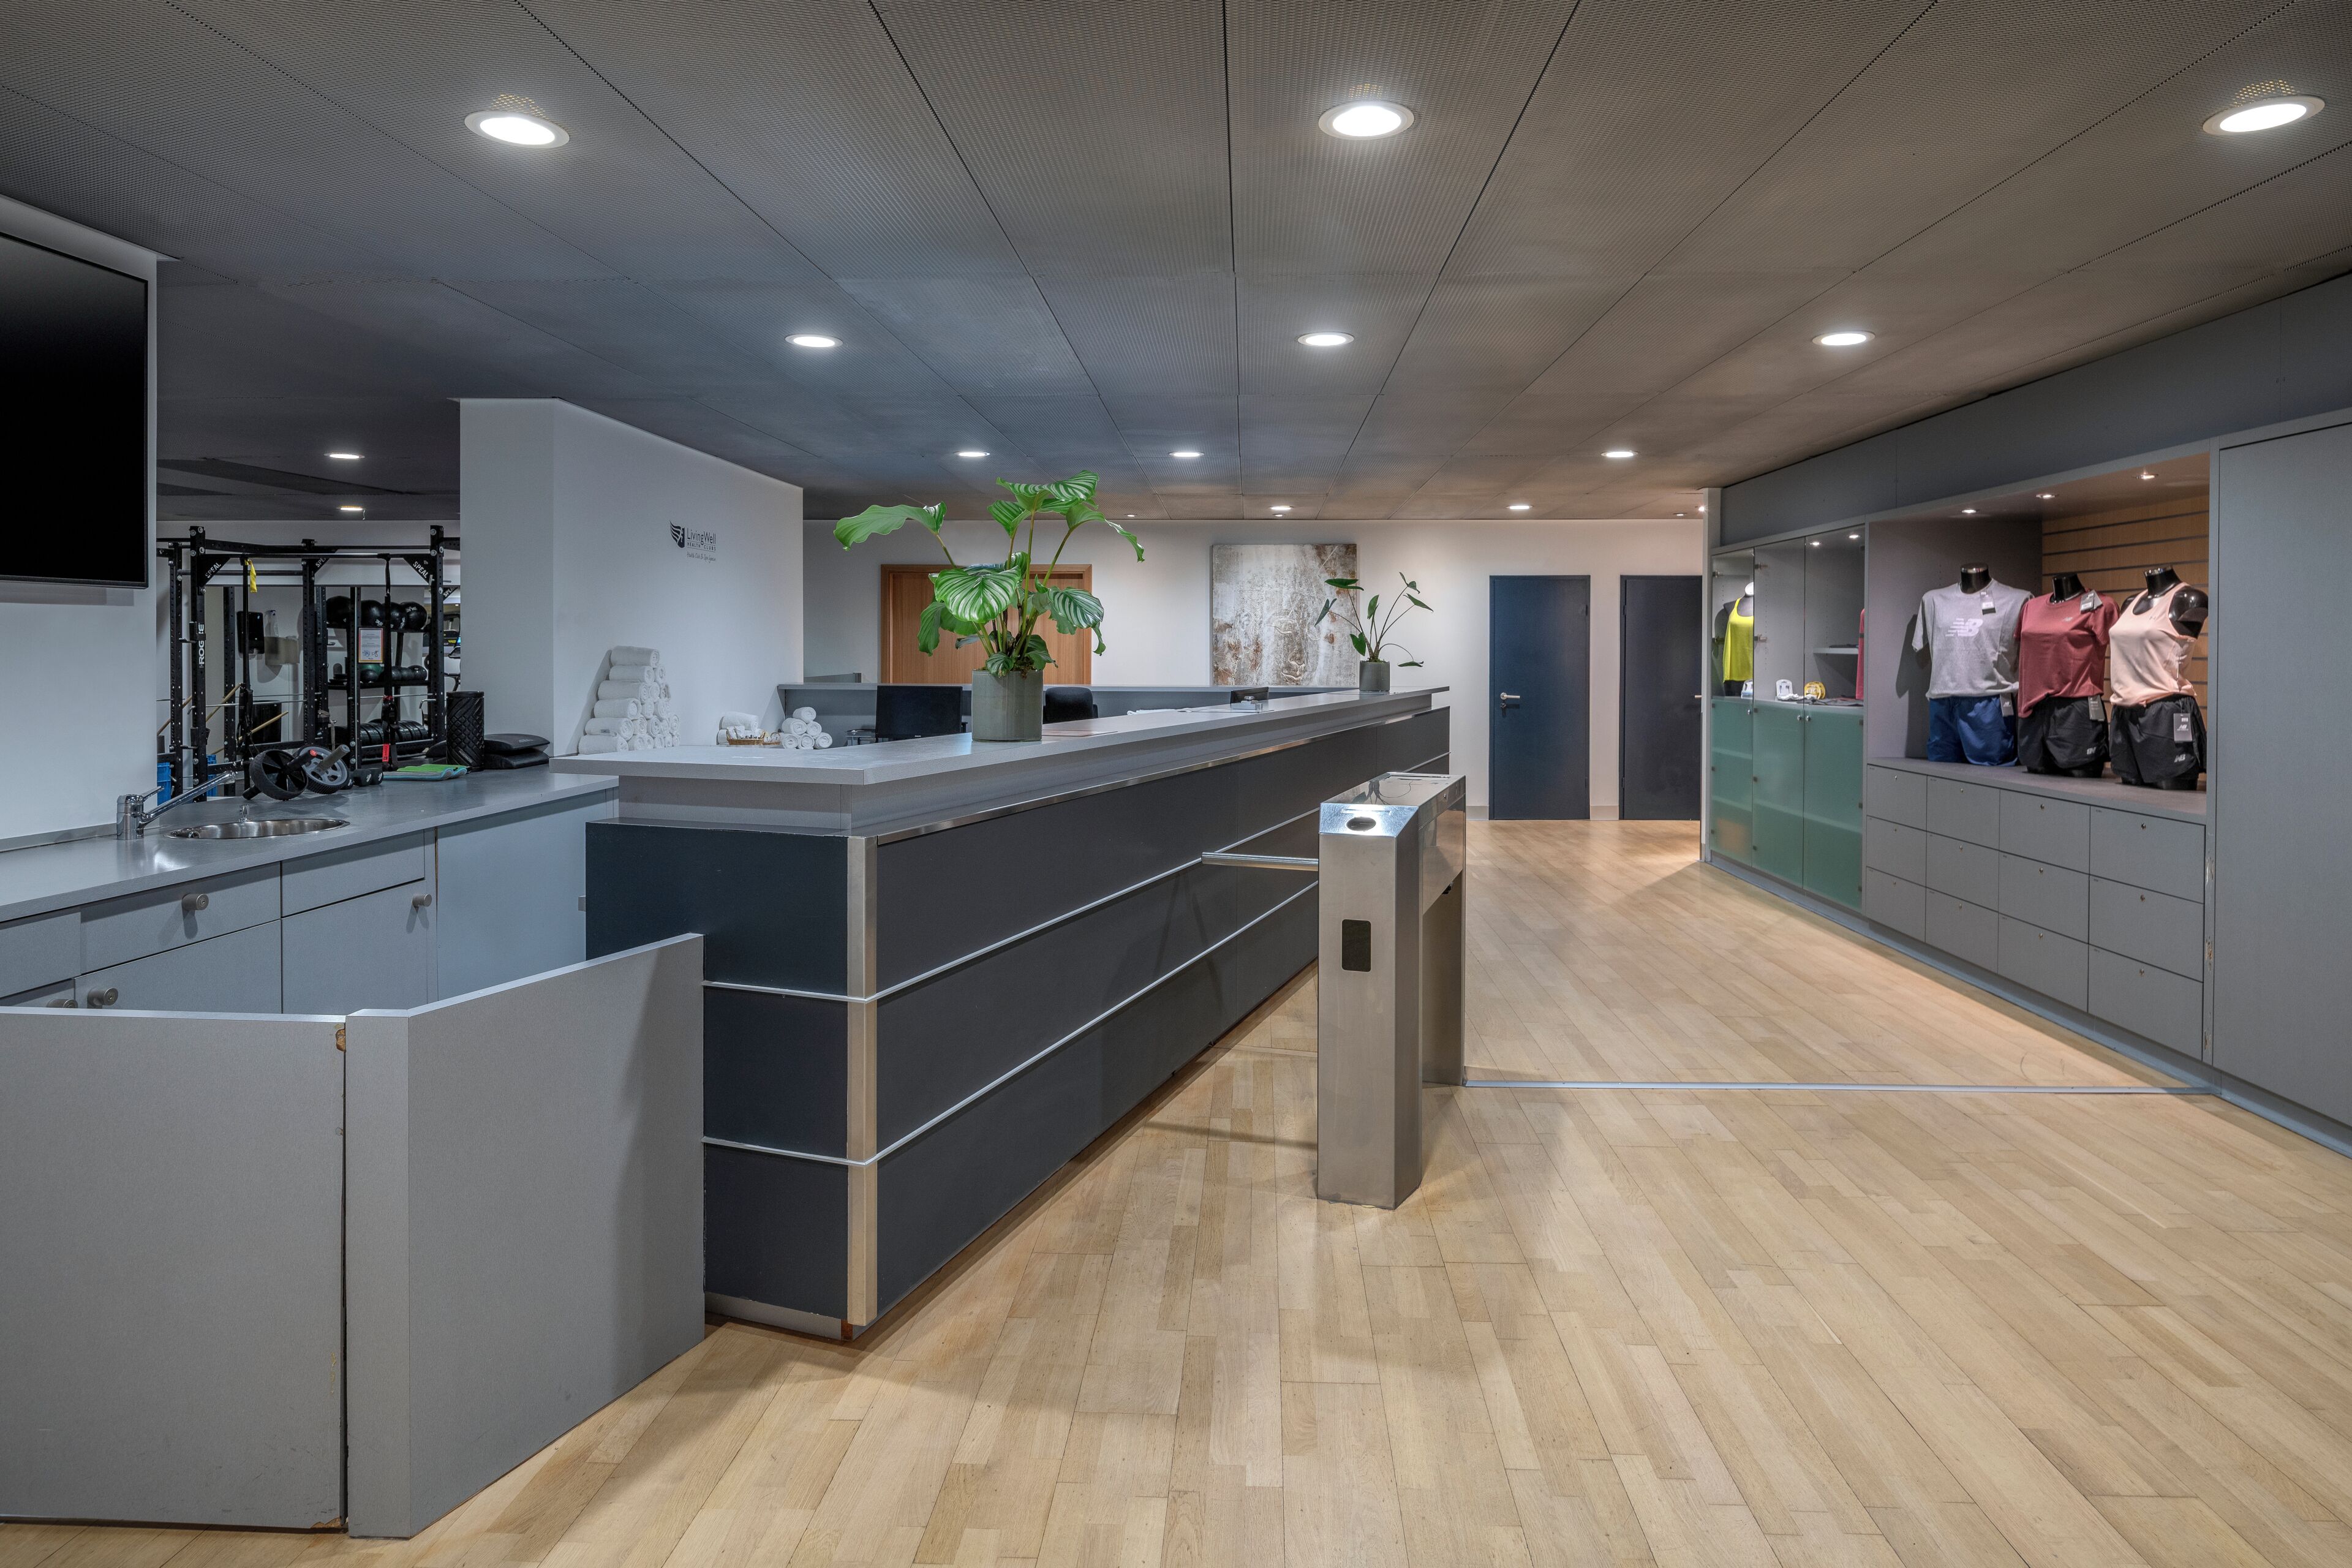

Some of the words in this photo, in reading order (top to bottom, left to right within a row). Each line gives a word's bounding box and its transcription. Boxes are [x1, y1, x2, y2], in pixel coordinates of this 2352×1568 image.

[687, 527, 716, 545] LivingWell
[205, 562, 221, 578] SPEAL
[413, 561, 429, 578] SPEAL
